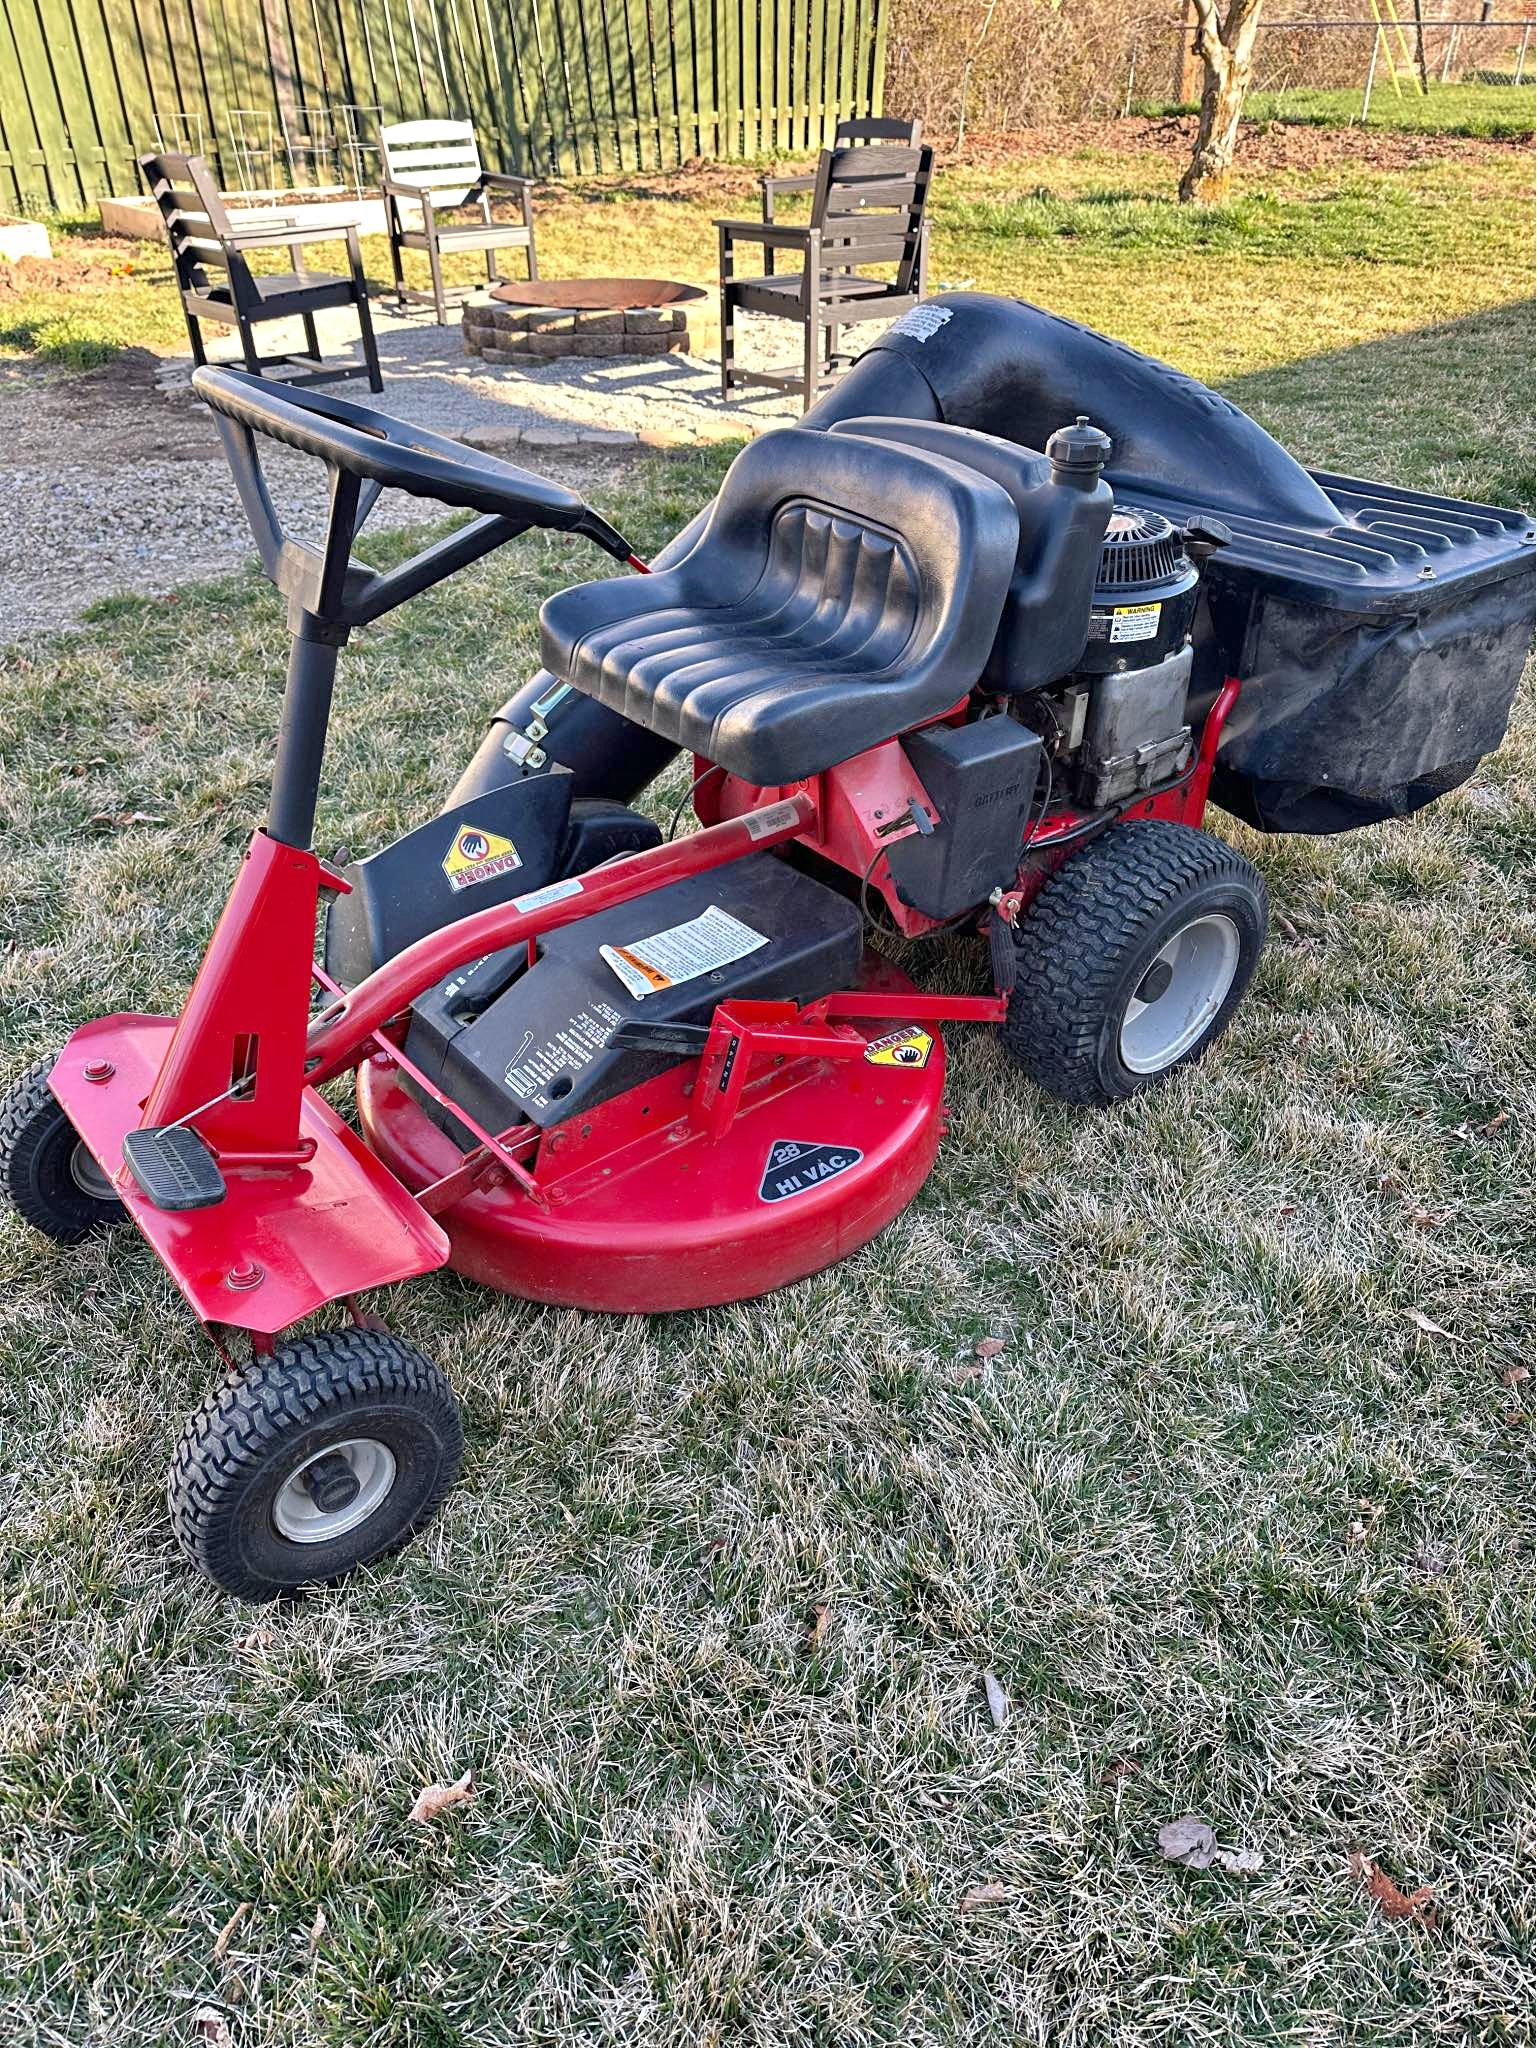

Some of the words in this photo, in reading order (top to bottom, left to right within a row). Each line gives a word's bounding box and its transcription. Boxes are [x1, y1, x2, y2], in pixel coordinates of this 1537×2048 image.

[1127, 606, 1155, 615] WARNING
[456, 856, 516, 885] DANGER
[866, 1028, 918, 1053] DANGER
[773, 1143, 801, 1163] 28
[775, 1175, 802, 1196] HI
